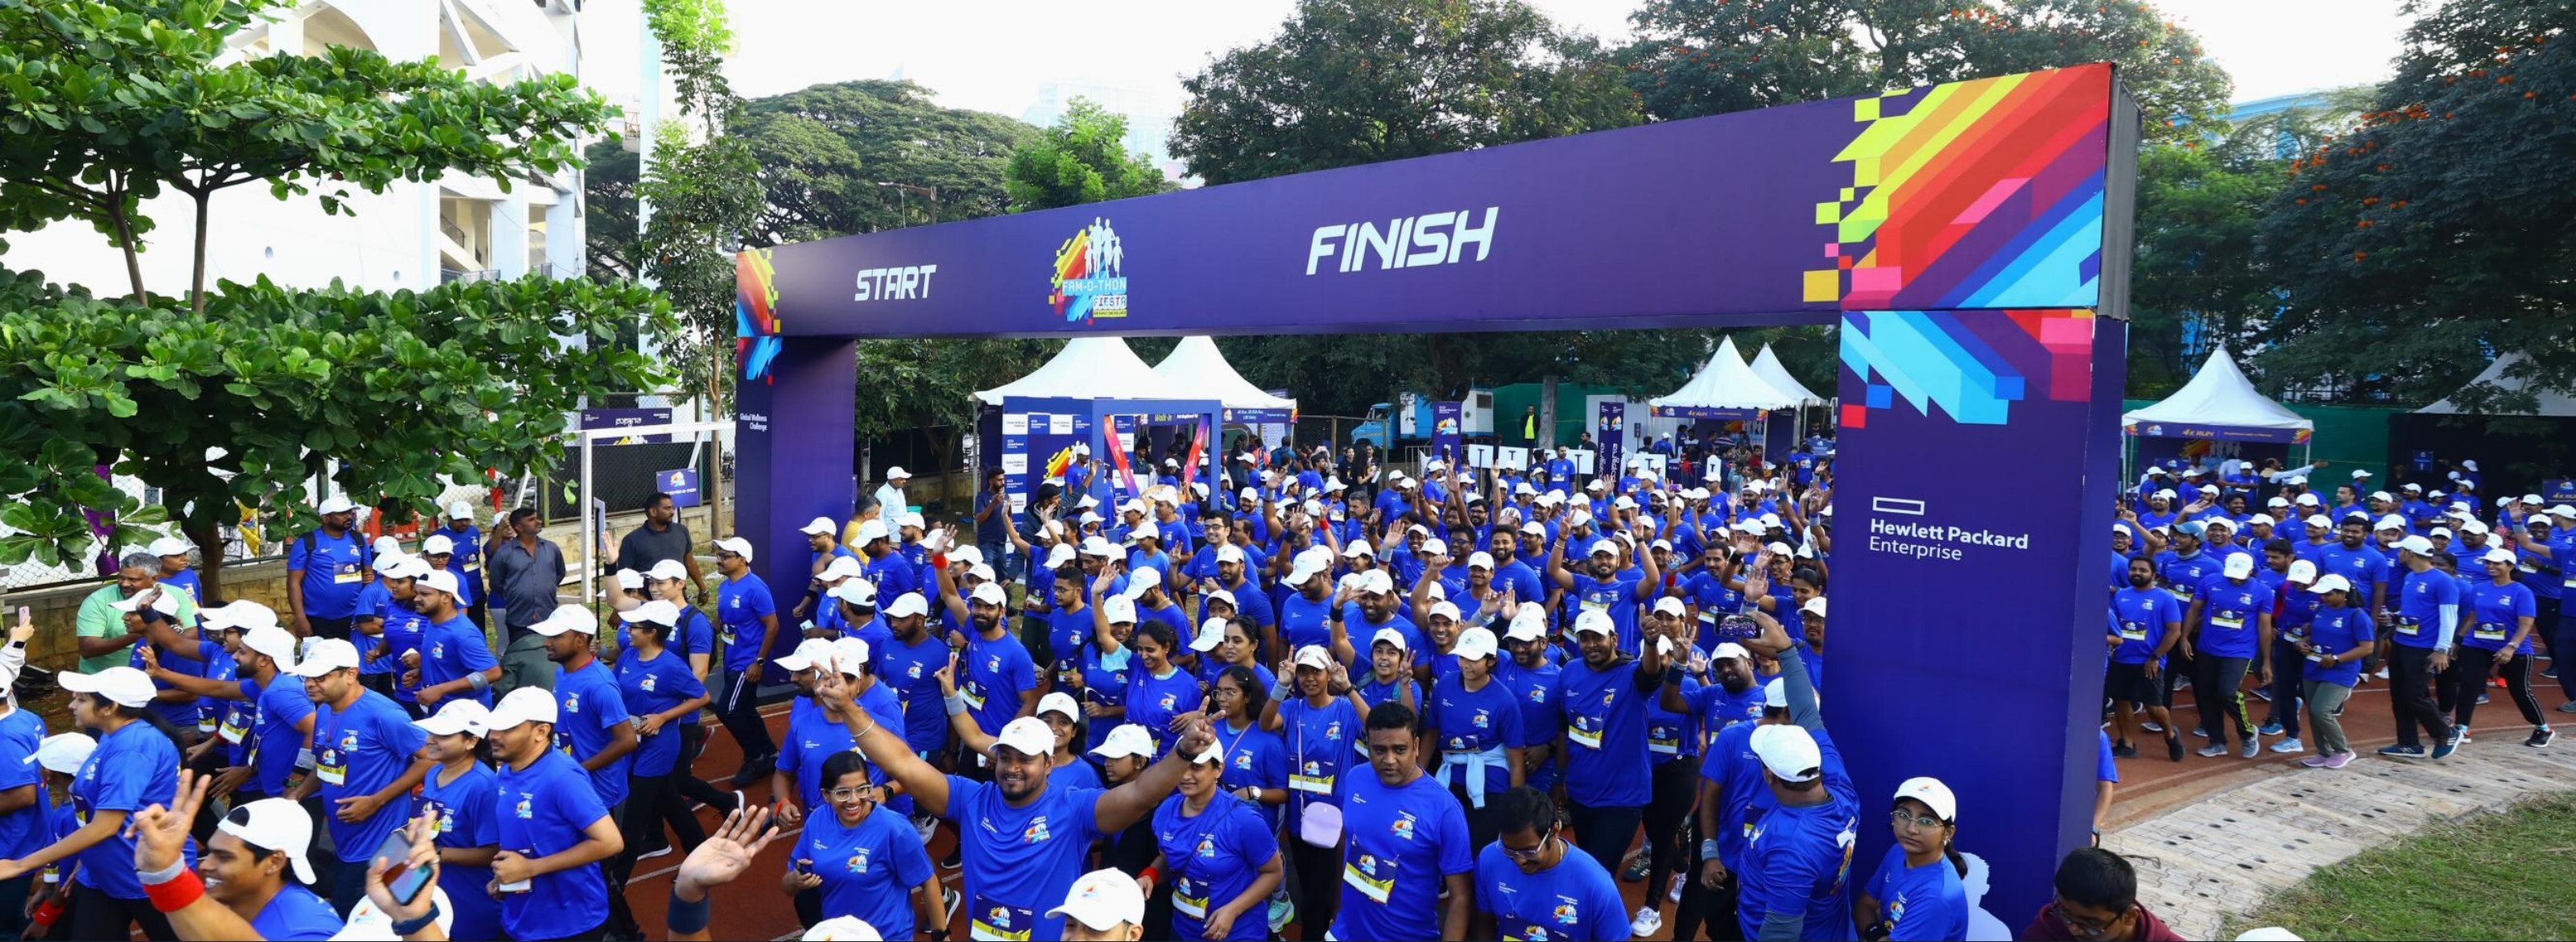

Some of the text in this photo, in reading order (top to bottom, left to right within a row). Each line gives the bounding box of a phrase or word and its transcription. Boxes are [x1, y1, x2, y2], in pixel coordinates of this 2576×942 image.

[1305, 206, 1499, 275] FINISH
[854, 264, 937, 301] START
[1063, 279, 1127, 292] FAM-O-THON
[1869, 535, 1962, 560] Enterprise
[1870, 518, 2029, 549] Hewlett Packard
